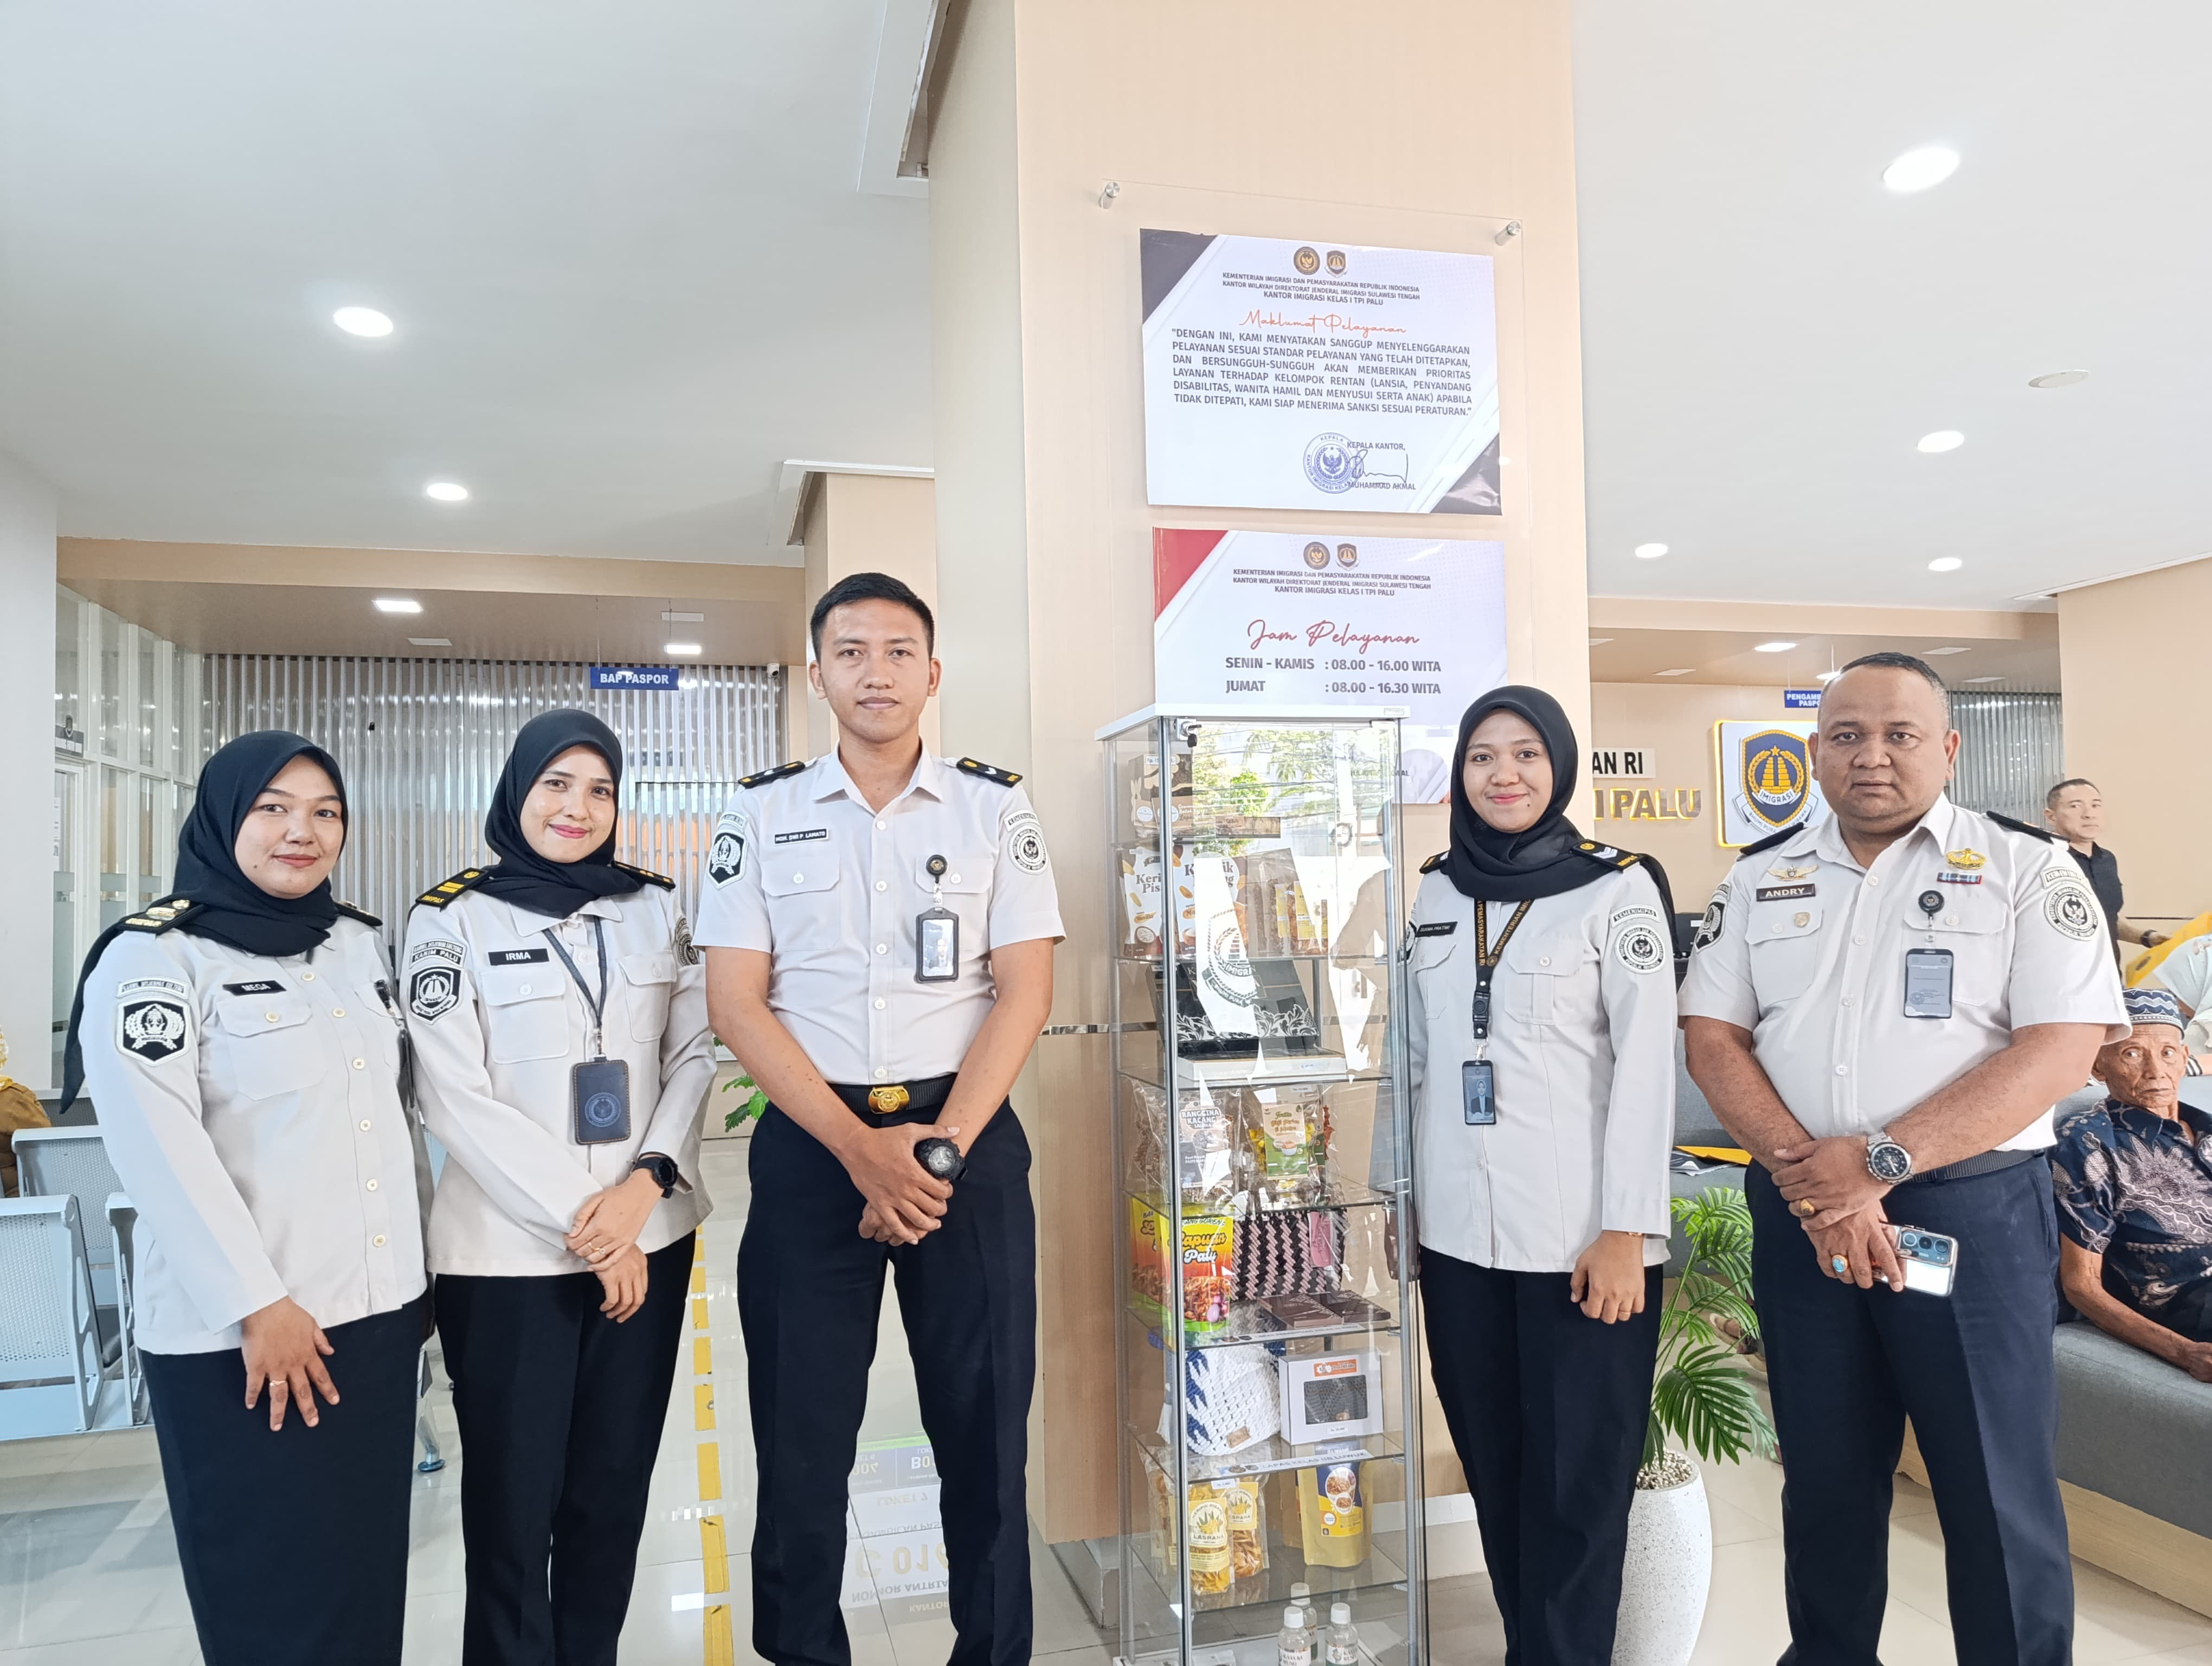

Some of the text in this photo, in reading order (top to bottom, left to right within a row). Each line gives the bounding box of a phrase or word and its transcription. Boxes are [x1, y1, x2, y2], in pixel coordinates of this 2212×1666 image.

[1223, 272, 1264, 281] KEMENTERIAN
[1307, 278, 1358, 287] PEMASYARAKATAN
[1388, 284, 1419, 292] INDONESIA
[1264, 291, 1292, 300] KANTOR
[1294, 293, 1325, 302] IMIGRASI
[1327, 296, 1348, 304] KELAS
[1239, 309, 1407, 338] Maklumat Pelayanan
[1219, 331, 1237, 341] INI,
[1239, 332, 1262, 342] KAMI
[1266, 334, 1326, 345] MENYATAKAN
[1330, 338, 1372, 348] SANGGUP
[1377, 341, 1470, 354] MENYELENGGARAKAN
[1172, 342, 1470, 368] PELAYANAN SESUAI STANDAR PELAYANAN YANG TELAH DITETAPKAN,
[1173, 355, 1471, 379] DAN BERSUNGGUH-SUNGGUH AKAN MEMBERIKAN PRIORITAS
[1173, 368, 1471, 391] LAYANAN TERHADAP KELOMPOK RENTAN (LANSIA, PENYANDANG
[1173, 381, 1472, 403] DISABILITAS, WANITA HAMIL DAN MENYUSUI SERTA ANAK) APABILA
[1174, 394, 1203, 403] TIDAK
[1204, 395, 1246, 406] DITEPATI,
[1249, 397, 1272, 407] KAMI
[1274, 398, 1295, 407] SIAP
[1297, 399, 1345, 410] MENERIMA
[1347, 401, 1379, 411] SANKSI
[1381, 403, 1412, 413] SESUAI
[1375, 443, 1406, 451] KANTOR,
[1258, 578, 1285, 586] WILAYAH
[1286, 579, 1321, 587] DIREKTORAT
[1322, 580, 1351, 588] JENDERAL
[1247, 619, 1420, 655] Jam Pelayanan
[1225, 657, 1263, 668] SENIN
[1275, 658, 1315, 670] KAMIS
[1331, 658, 1366, 672] 08.00
[1377, 659, 1409, 672] 16.00
[1411, 659, 1442, 672] WITA
[600, 674, 668, 684] BAP PASPOR
[1225, 680, 1265, 692] JUMAT
[1332, 682, 1366, 693] 08.00
[1377, 682, 1409, 694] 16.30
[1411, 683, 1441, 694] WITA
[1624, 752, 1643, 774] RI
[1611, 789, 1701, 819] PALU
[1760, 791, 1793, 803] IMIGRASI
[1765, 886, 1805, 898] ANDRY
[1615, 908, 1656, 921] KEMENIMIPAS
[1494, 912, 1523, 954] KEMENTERIAN
[414, 949, 458, 962] KANIM PALU
[505, 952, 531, 961] IRMA
[242, 983, 271, 991] MEGA
[1192, 1504, 1208, 1519] KERIPIK
